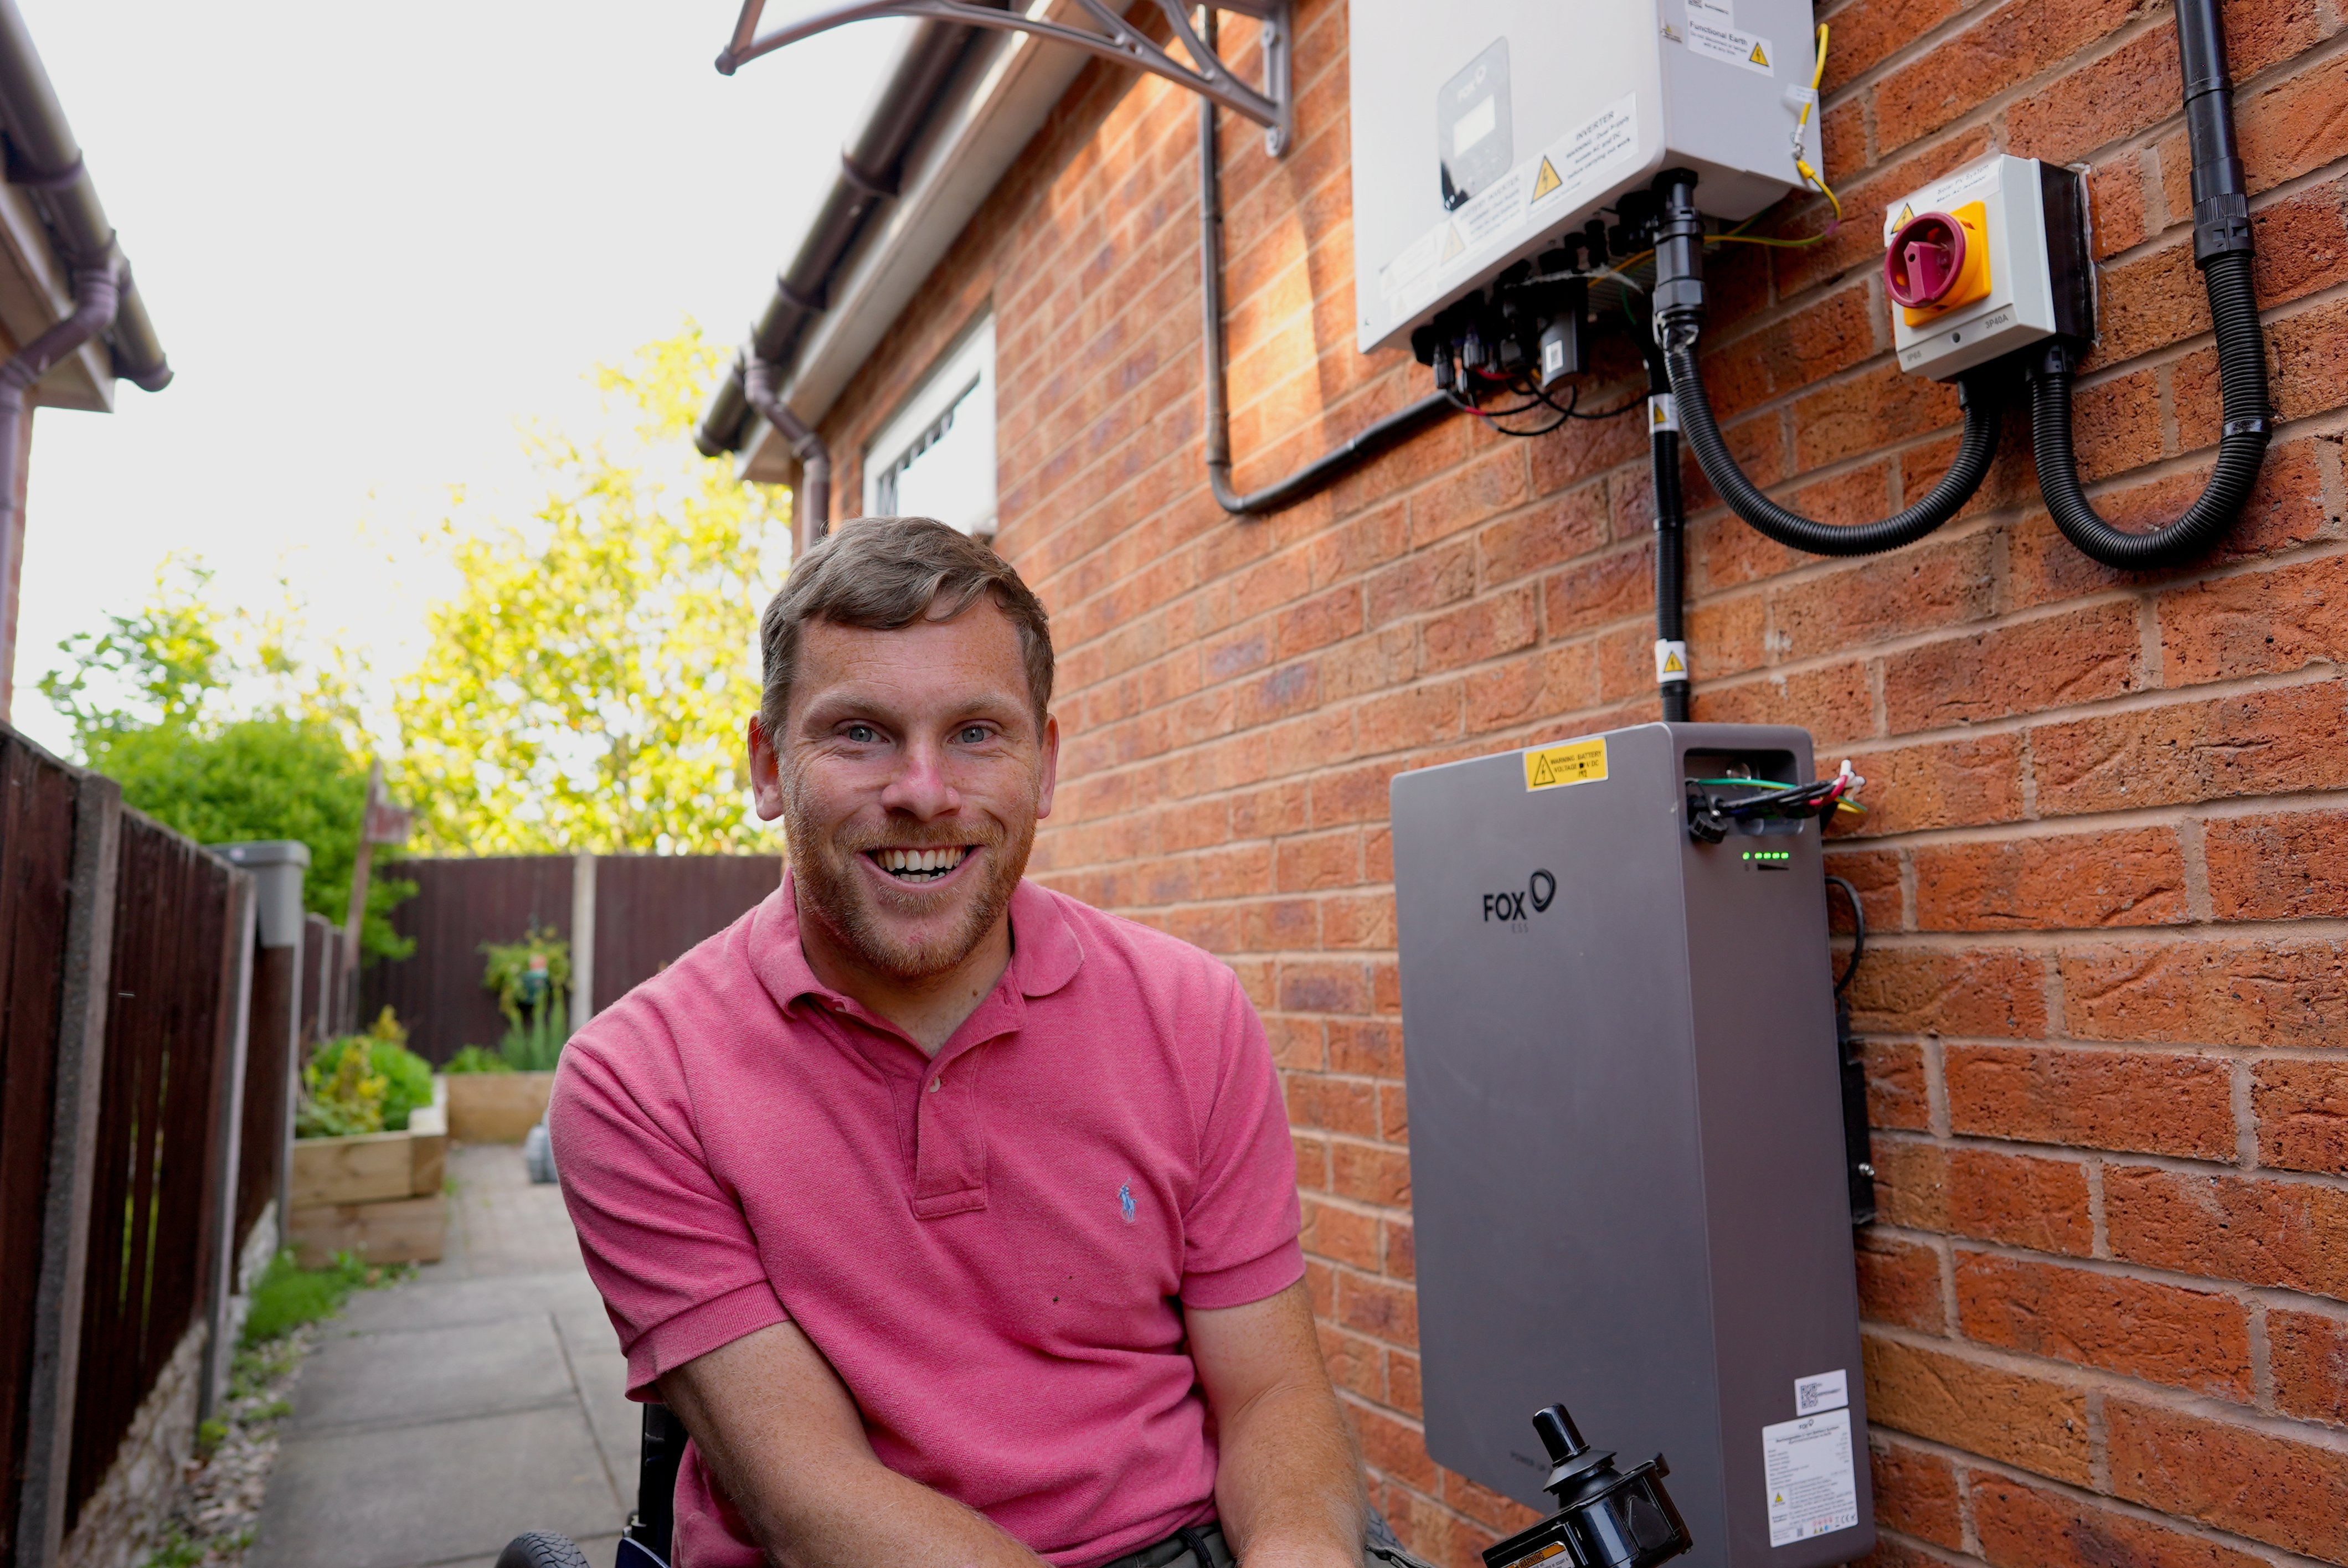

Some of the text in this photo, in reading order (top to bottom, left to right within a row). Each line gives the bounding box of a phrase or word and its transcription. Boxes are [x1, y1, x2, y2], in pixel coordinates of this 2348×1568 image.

[1690, 20, 1727, 39] Functional
[1729, 34, 1748, 46] Earth
[1577, 111, 1614, 141] INVERTER
[1966, 164, 1989, 180] System
[1985, 314, 2009, 329] 3P40A
[1907, 350, 1922, 362] IP65
[1551, 750, 1602, 765] WARNING BATTERY
[1554, 764, 1577, 772] VOLTAGE
[1484, 891, 1527, 922] FOX
[1511, 923, 1528, 934] ESS
[1520, 1552, 1544, 1568] WARNING
